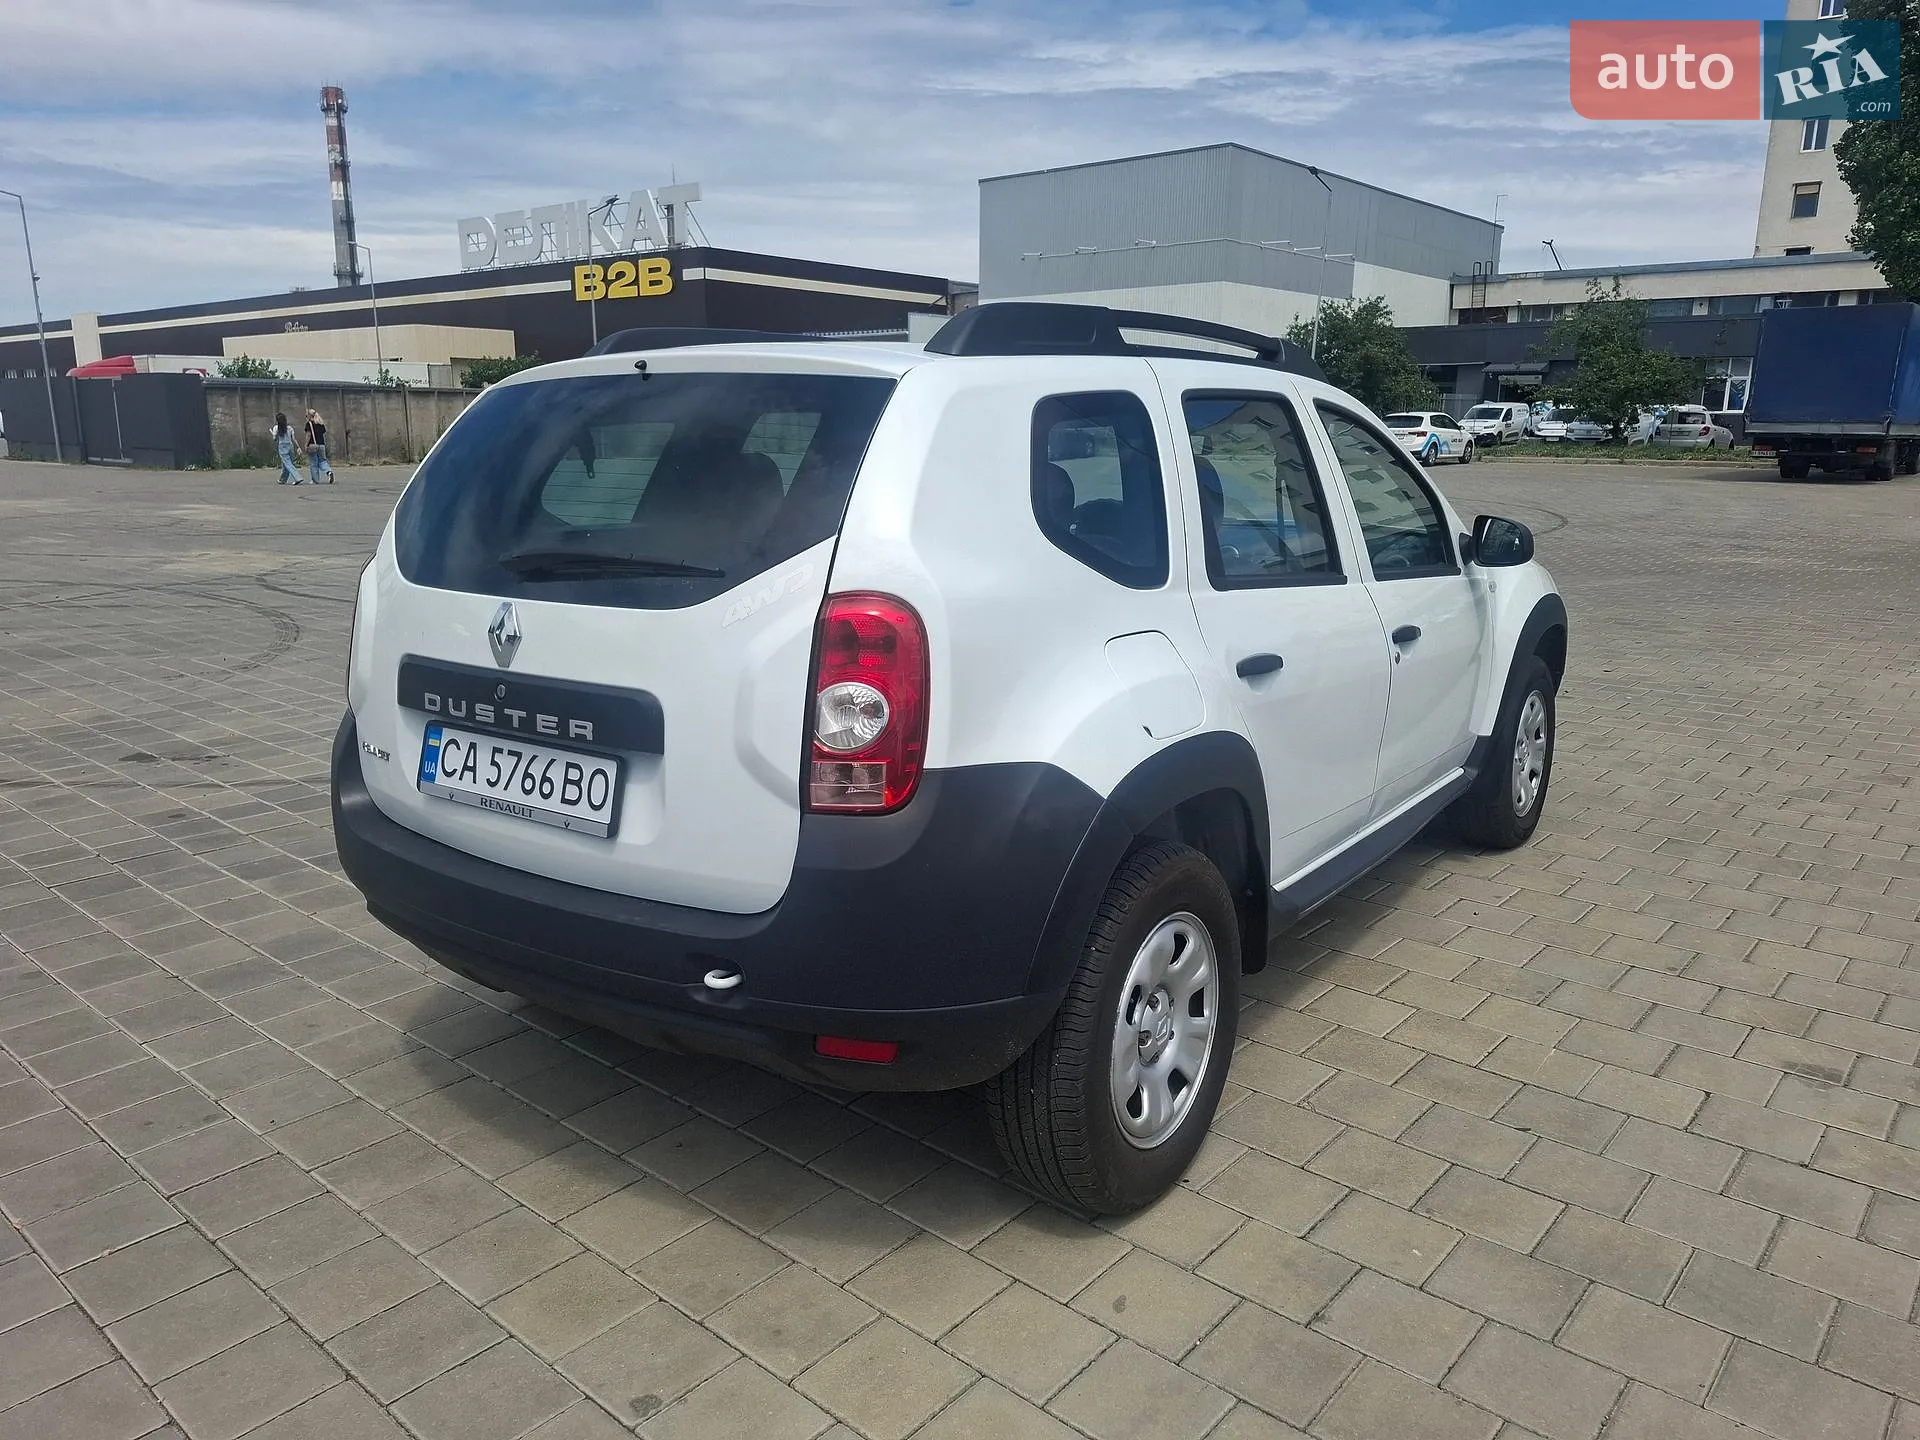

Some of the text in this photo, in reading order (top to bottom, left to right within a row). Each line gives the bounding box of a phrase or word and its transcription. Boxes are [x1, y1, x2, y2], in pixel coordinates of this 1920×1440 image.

[574, 257, 674, 302] B2B
[424, 692, 594, 741] DUSTER
[424, 760, 436, 776] UA
[440, 738, 479, 785] CA
[486, 746, 557, 800] 5766
[560, 761, 610, 812] BO
[480, 797, 535, 819] RENAULT
